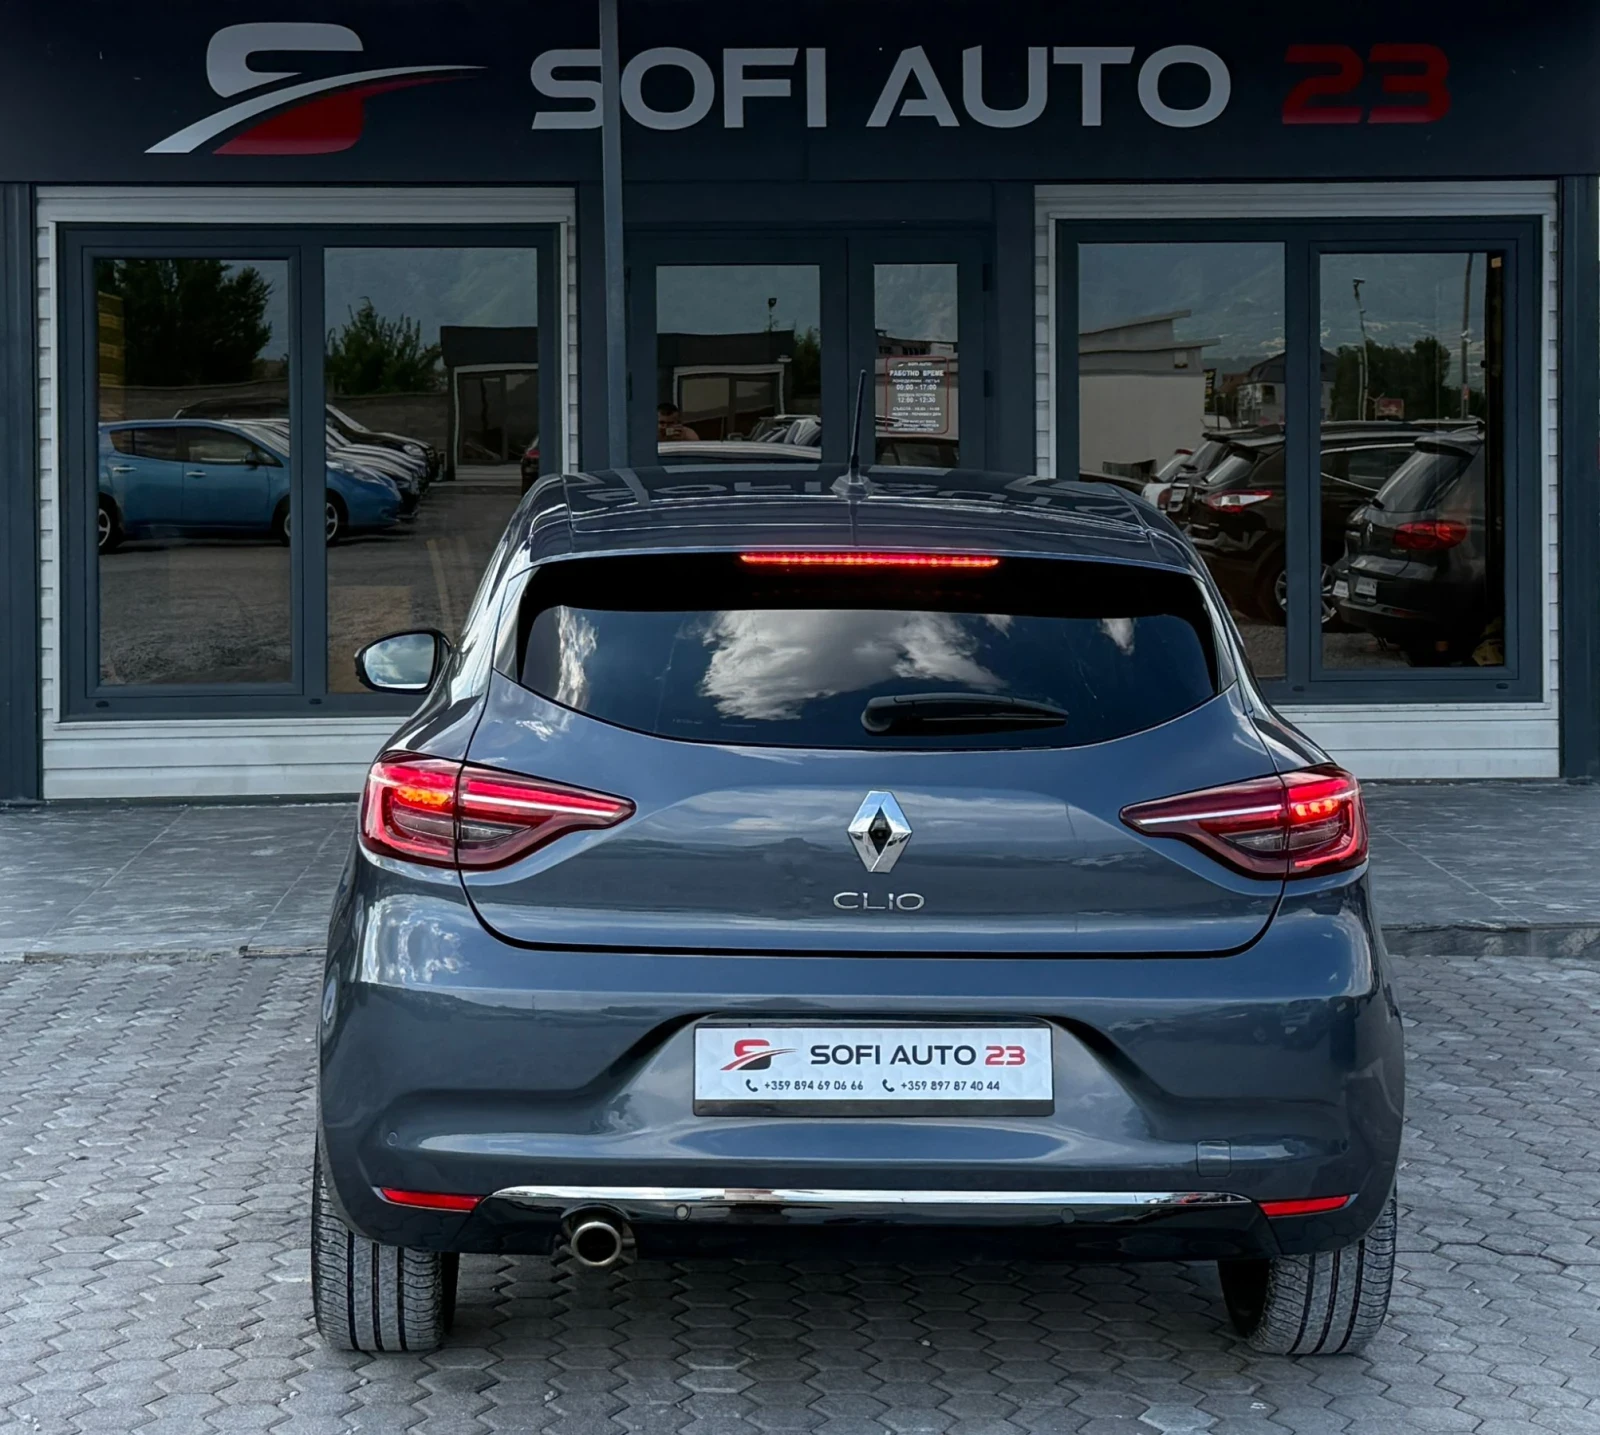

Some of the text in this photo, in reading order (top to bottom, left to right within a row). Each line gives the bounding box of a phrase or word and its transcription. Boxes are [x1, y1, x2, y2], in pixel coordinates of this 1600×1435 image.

[530, 42, 1452, 132] SOFI AUTO 23
[833, 891, 925, 910] CLIO
[810, 1044, 1027, 1067] SOFI AUTO 23
[764, 1080, 864, 1091] +359 894 69 06 66
[900, 1080, 1000, 1092] +359 897 87 40 44
